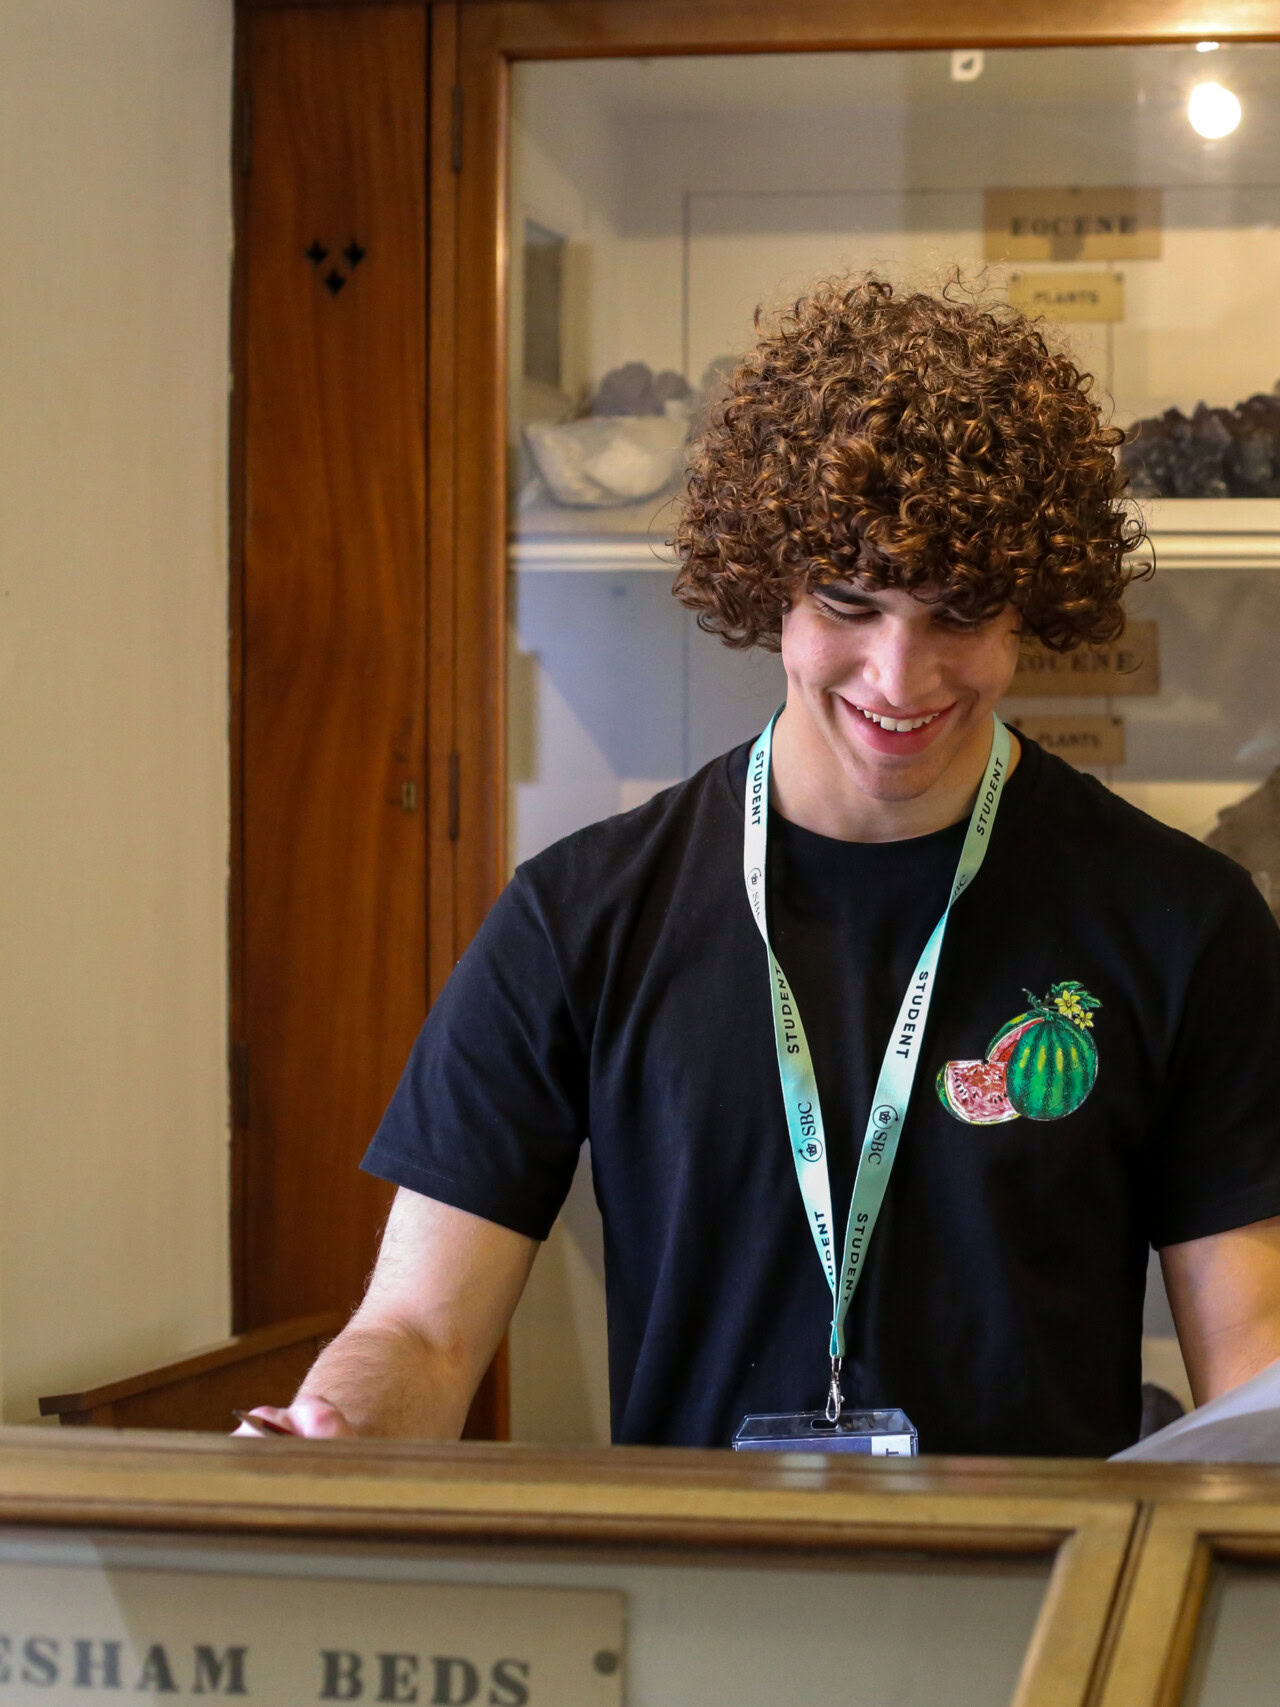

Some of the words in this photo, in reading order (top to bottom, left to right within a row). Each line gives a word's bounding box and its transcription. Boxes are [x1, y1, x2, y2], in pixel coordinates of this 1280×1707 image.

[1010, 215, 1137, 236] EOCENE
[751, 750, 766, 826] STUDENT
[976, 757, 1004, 836] STUDENT
[774, 964, 801, 1055] STUDENT
[896, 971, 929, 1059] STUDENT
[797, 1101, 817, 1137] SBC
[867, 1129, 888, 1166] SBC
[844, 1212, 869, 1303] STUDENT
[0, 1634, 249, 1696] SHAM
[319, 1649, 531, 1707] BEDS
